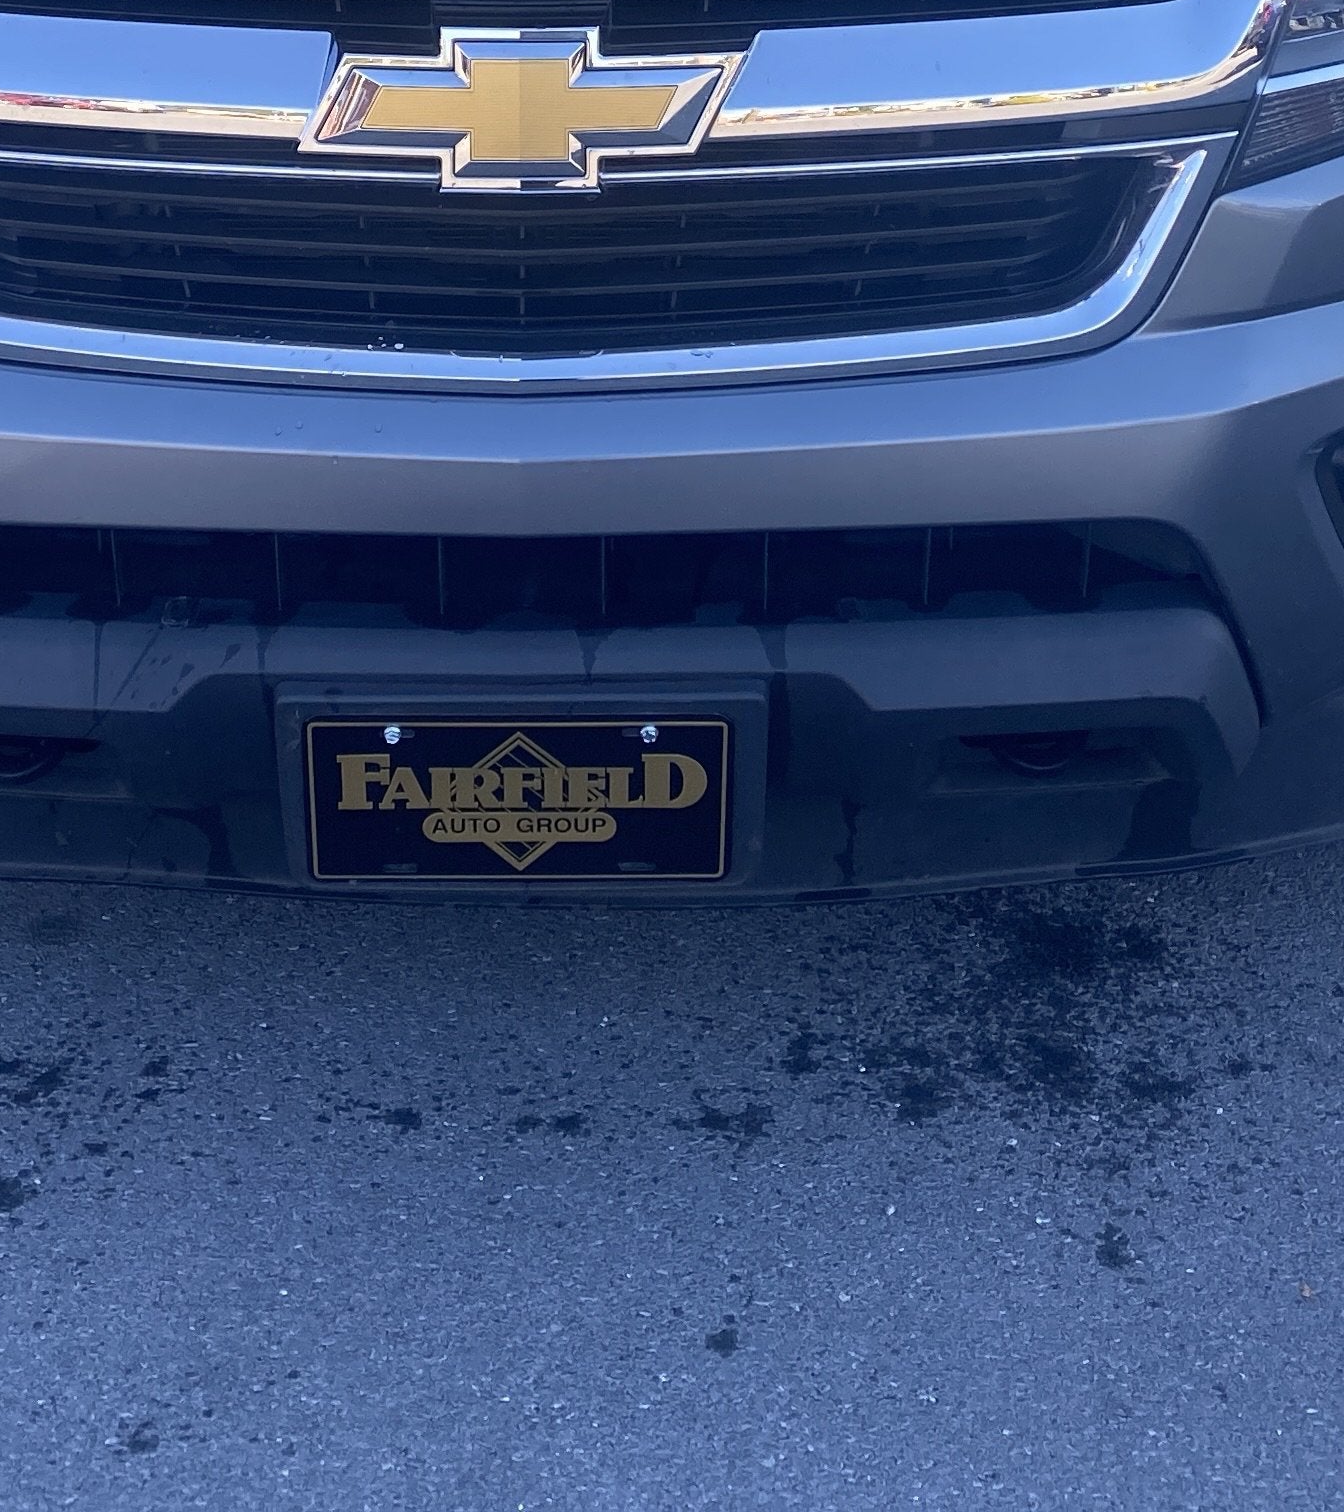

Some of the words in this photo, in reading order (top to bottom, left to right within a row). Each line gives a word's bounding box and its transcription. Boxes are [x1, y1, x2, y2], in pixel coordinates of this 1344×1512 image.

[336, 753, 708, 810] FAIRFIELD
[432, 817, 501, 834] AUTO
[516, 817, 607, 834] GROUP
